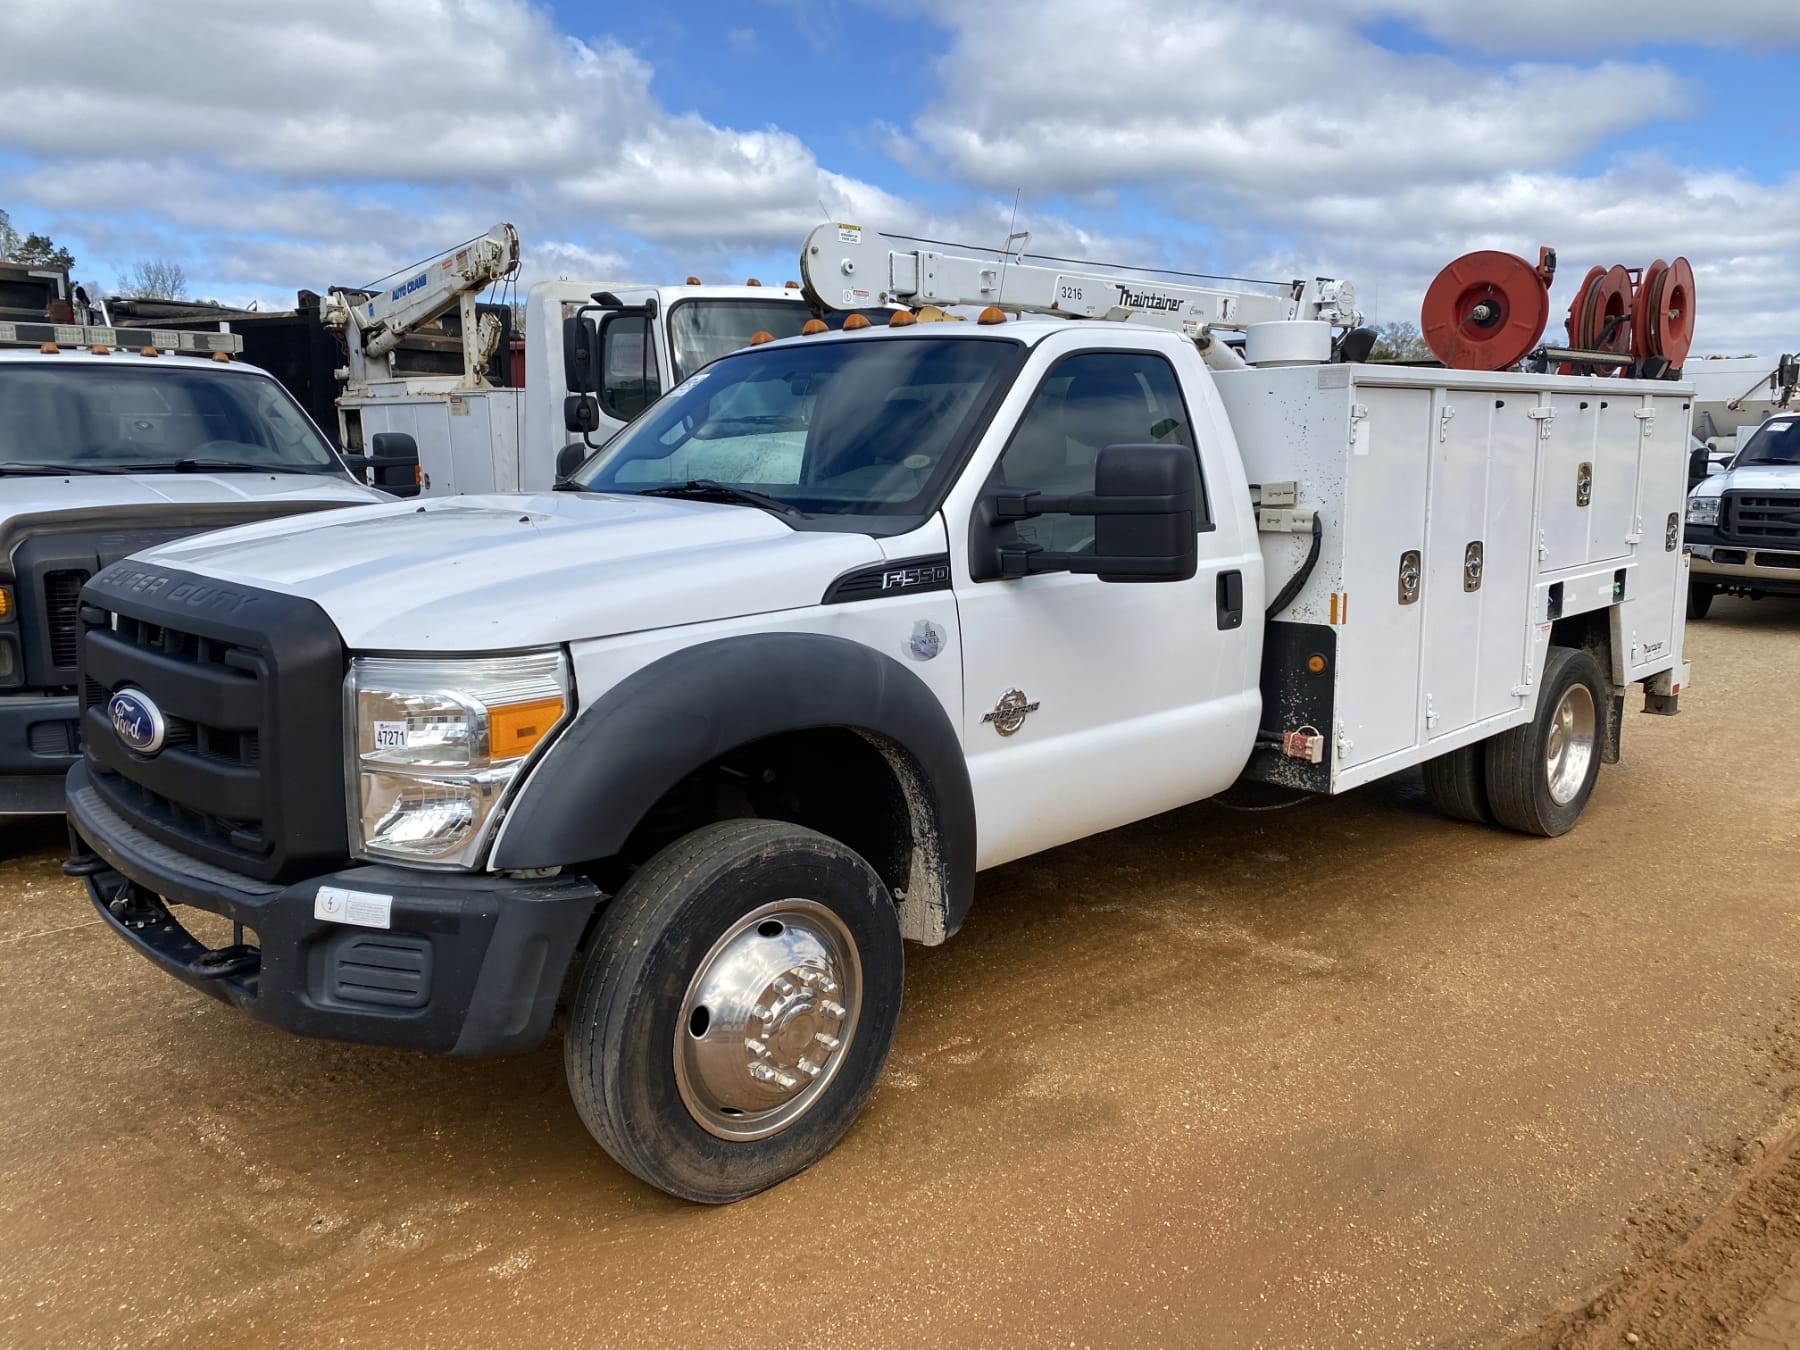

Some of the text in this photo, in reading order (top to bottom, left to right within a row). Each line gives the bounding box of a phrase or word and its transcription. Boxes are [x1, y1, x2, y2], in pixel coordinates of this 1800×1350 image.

[1061, 286, 1083, 300] 3216
[1115, 284, 1184, 312] Maintainer
[104, 567, 259, 614] SUPER DUTY
[113, 700, 141, 740] Ford
[377, 730, 405, 746] 47271
